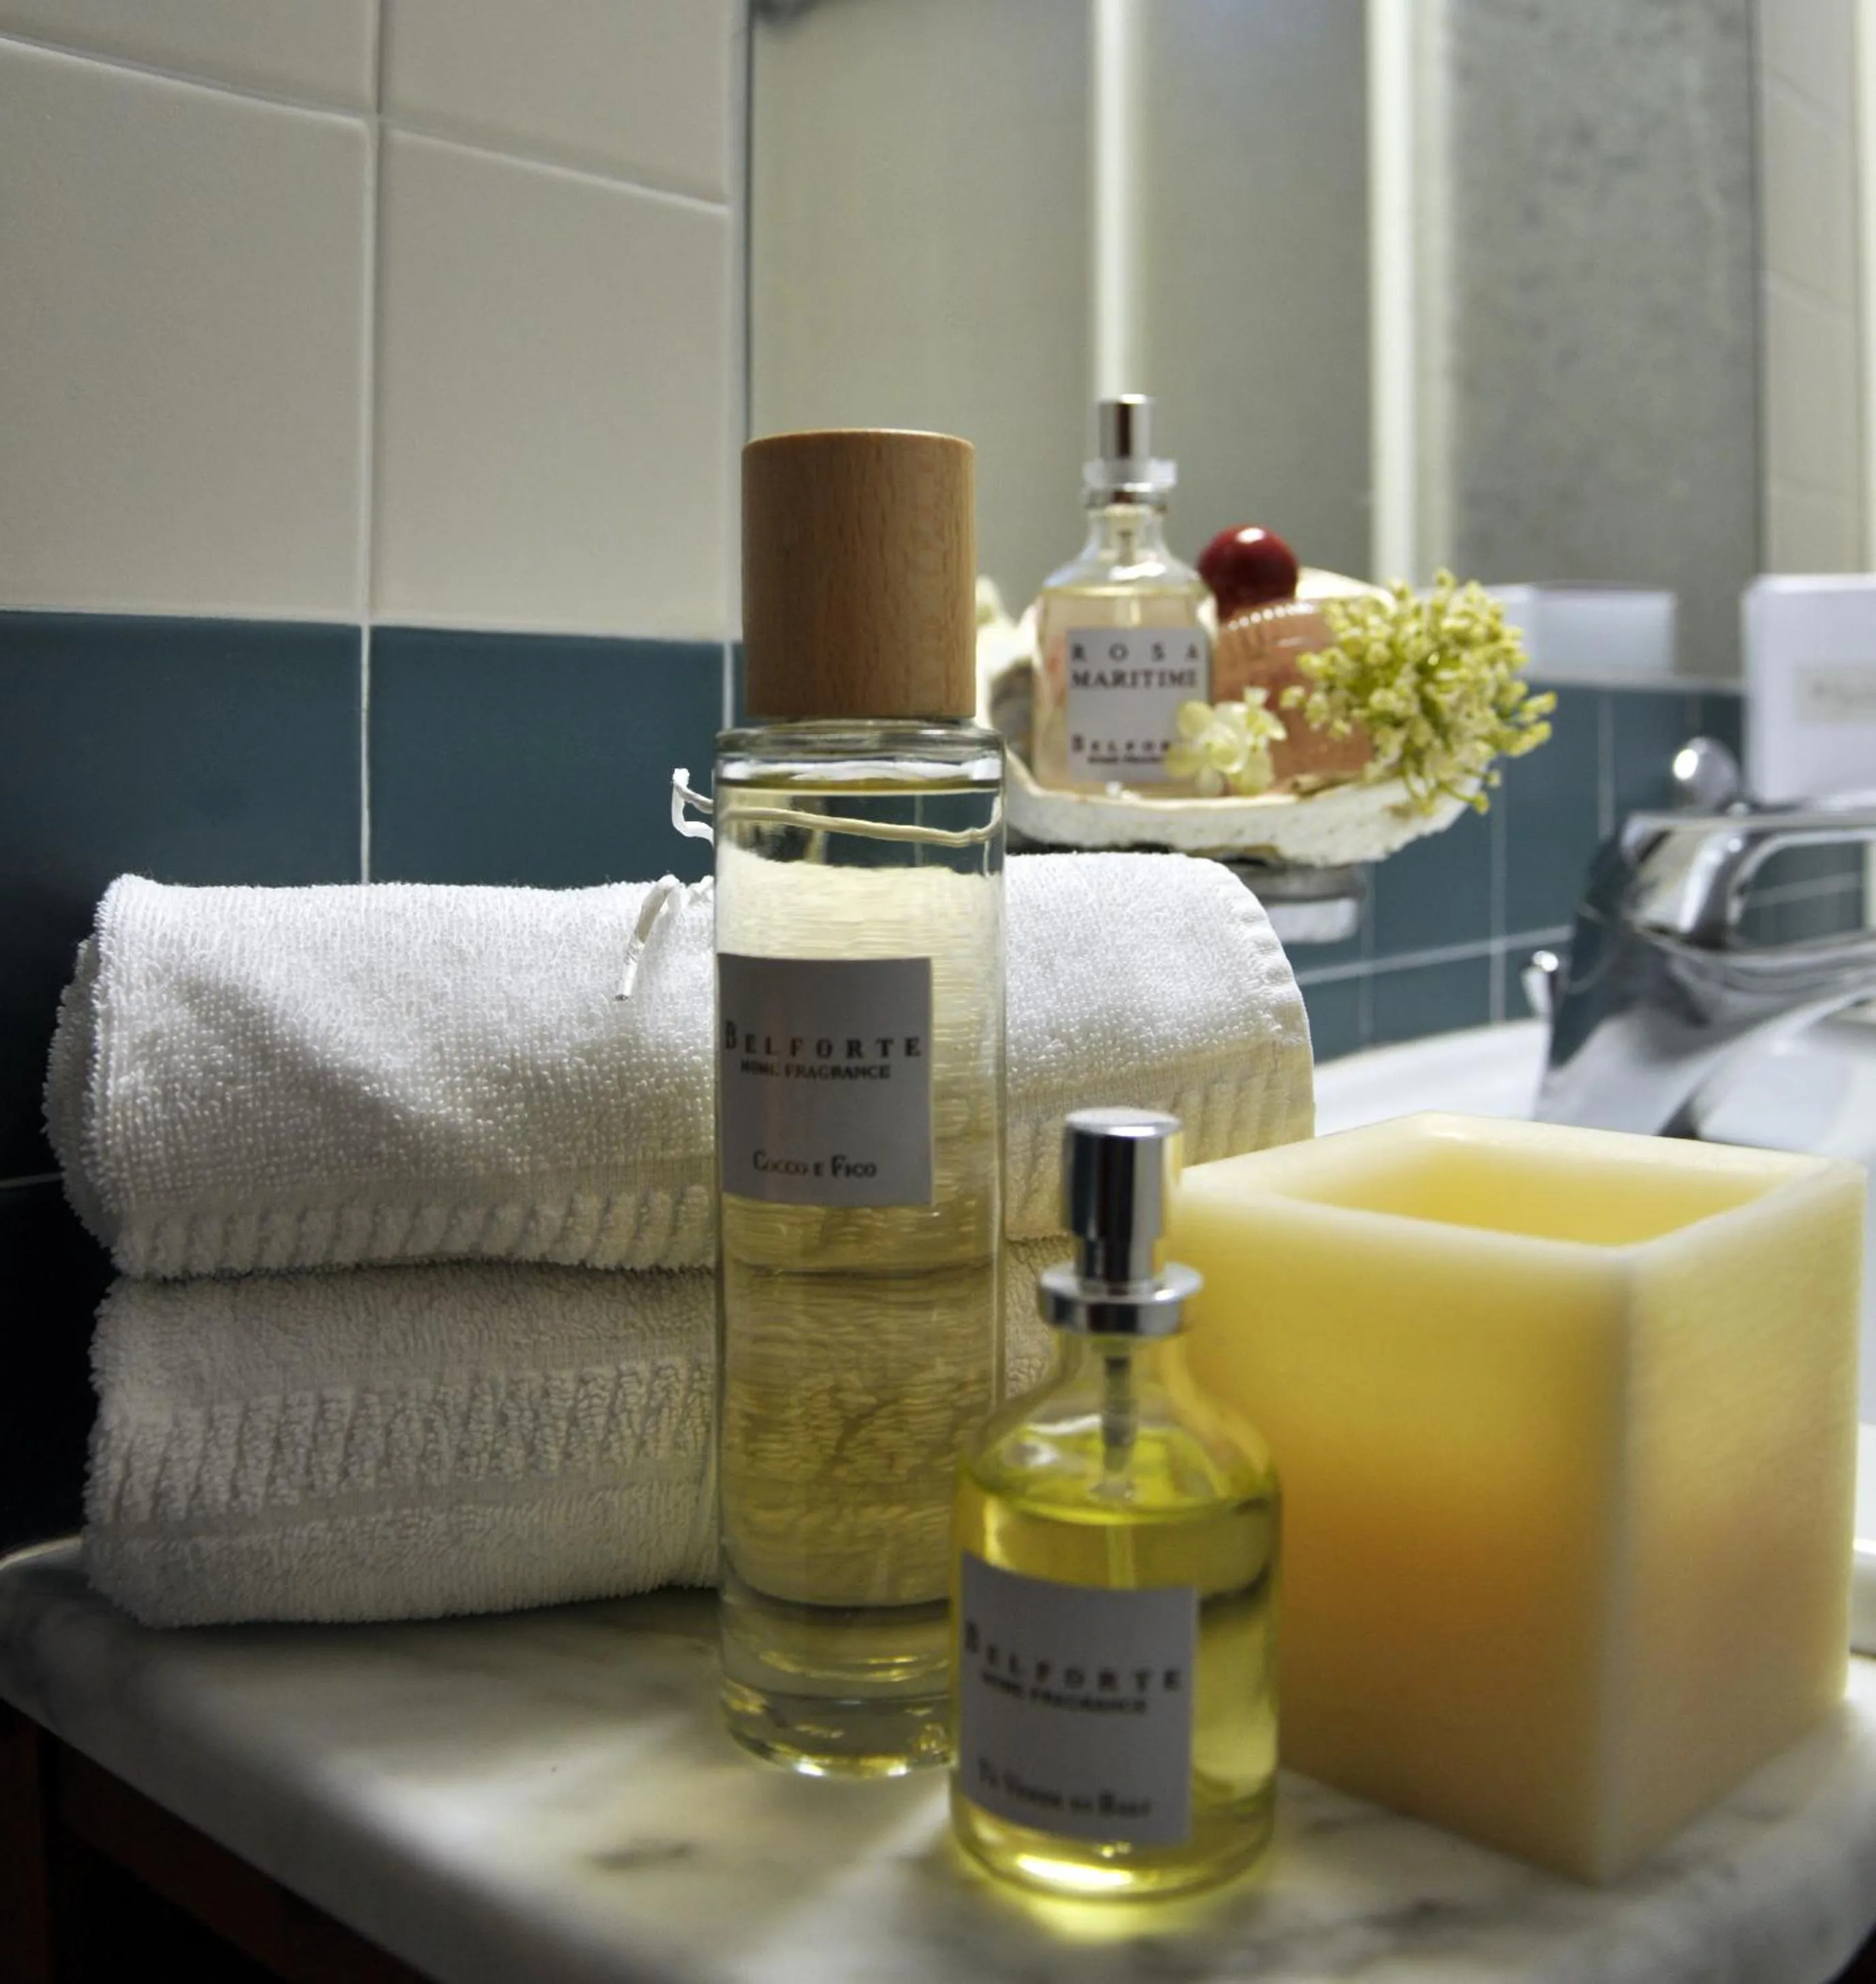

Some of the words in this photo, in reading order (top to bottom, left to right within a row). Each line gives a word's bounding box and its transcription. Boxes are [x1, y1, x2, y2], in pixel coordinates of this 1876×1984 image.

[1072, 669, 1197, 688] MARITIME
[725, 1021, 921, 1058] BELFORTE
[785, 1064, 891, 1080] FRAGRANCE
